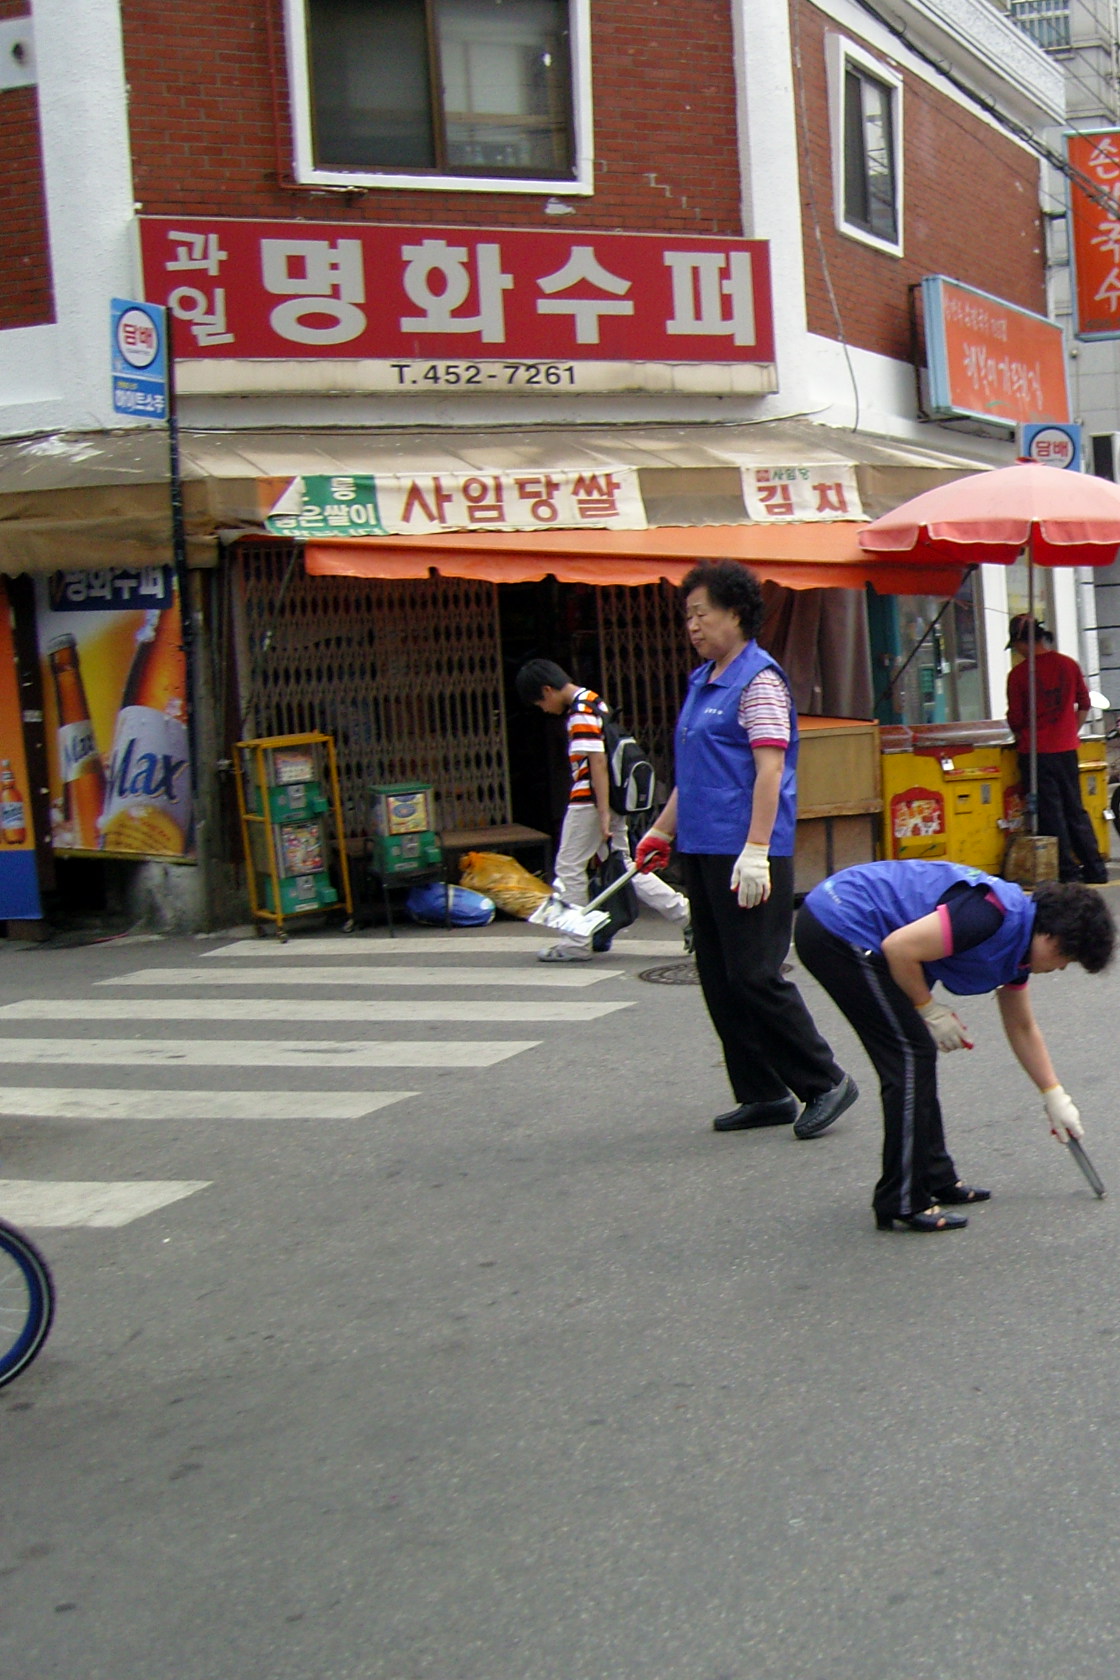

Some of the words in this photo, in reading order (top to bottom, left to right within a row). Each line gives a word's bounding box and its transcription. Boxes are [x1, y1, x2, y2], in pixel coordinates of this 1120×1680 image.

[165, 230, 236, 347] 과일
[260, 238, 757, 347] 명화수퍼
[122, 322, 154, 349] 담배
[390, 362, 577, 386] T.452-7261
[1035, 440, 1069, 457] 담배
[400, 472, 622, 527] 사임당쌀
[757, 482, 850, 516] 김치
